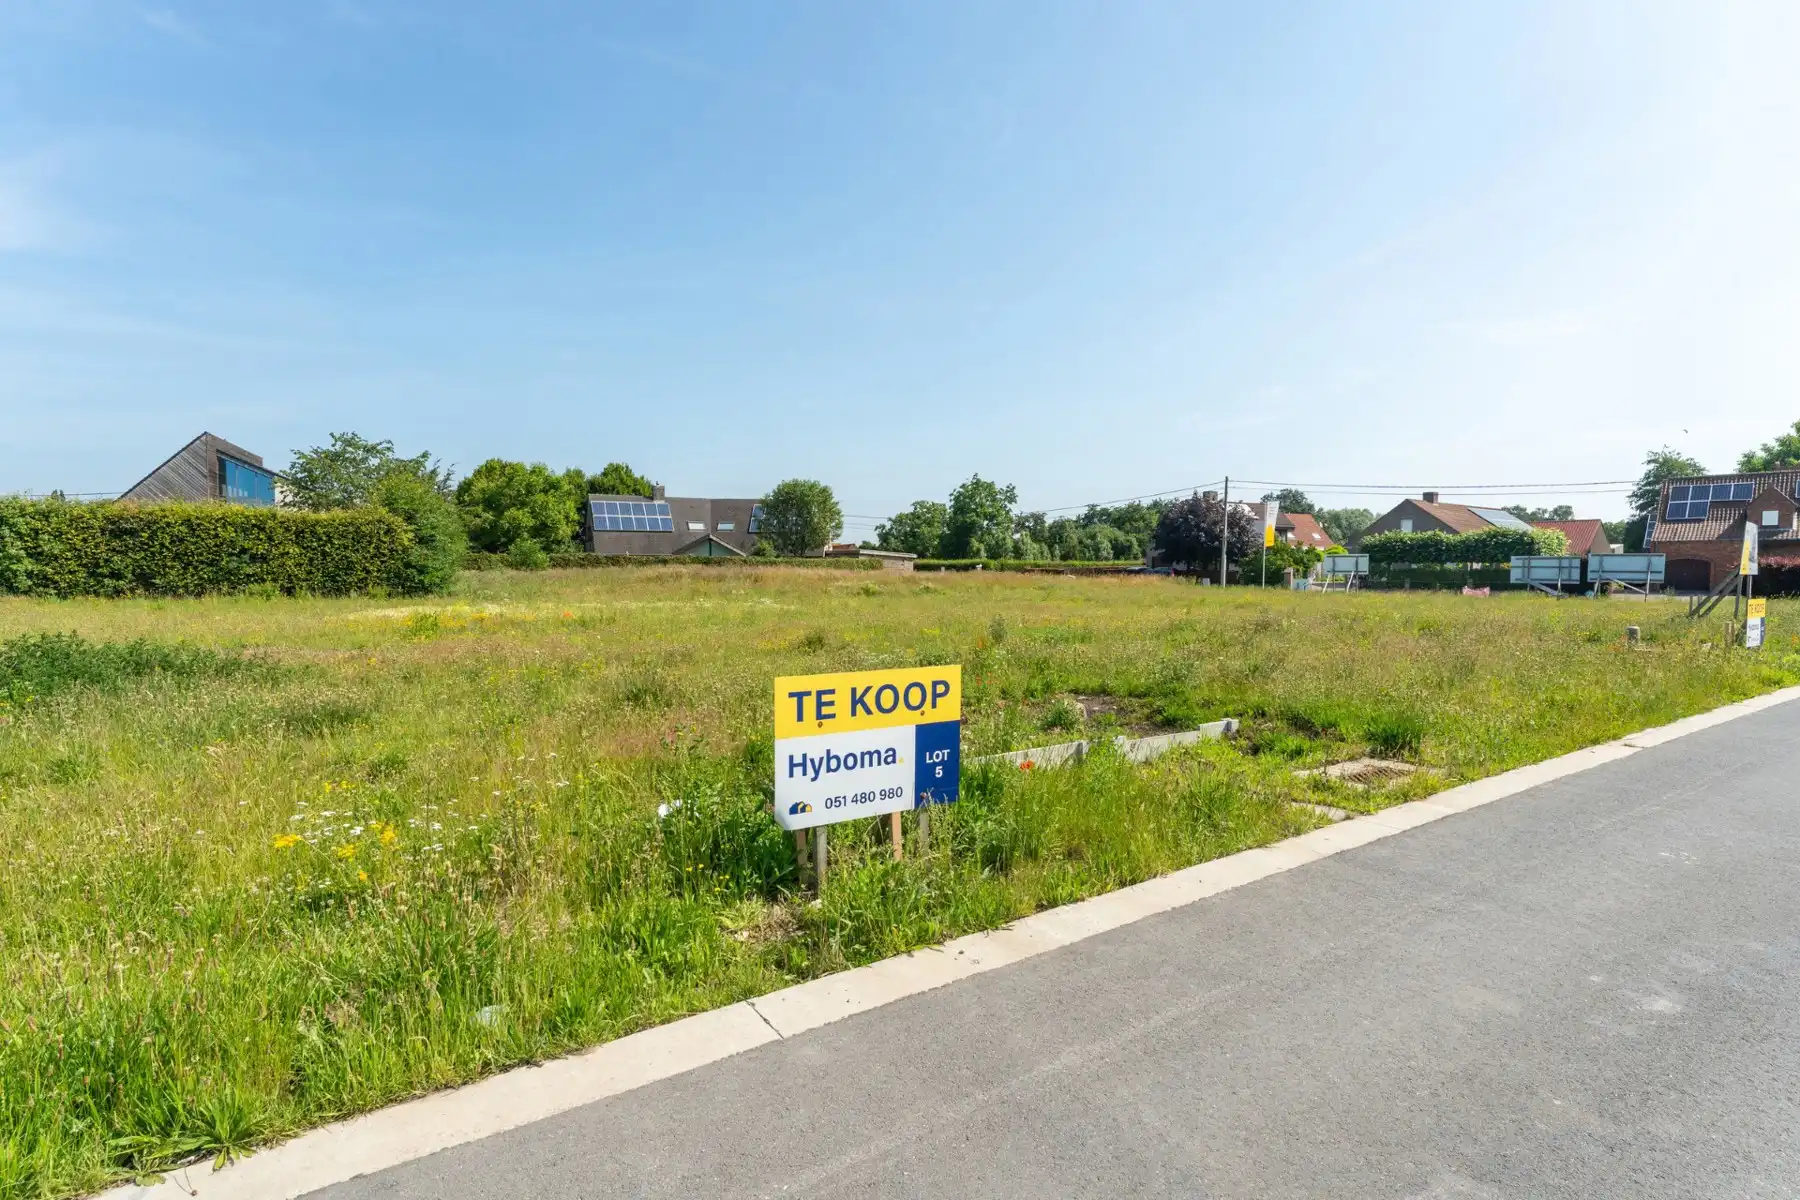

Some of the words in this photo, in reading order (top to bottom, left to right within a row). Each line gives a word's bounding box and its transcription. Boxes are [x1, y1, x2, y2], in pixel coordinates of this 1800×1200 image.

[788, 689, 836, 722] TE
[850, 680, 950, 717] KOOP
[925, 749, 950, 763] LOT
[935, 766, 943, 777] 5
[825, 795, 847, 809] 051
[851, 791, 876, 804] 480
[879, 787, 903, 800] 980
